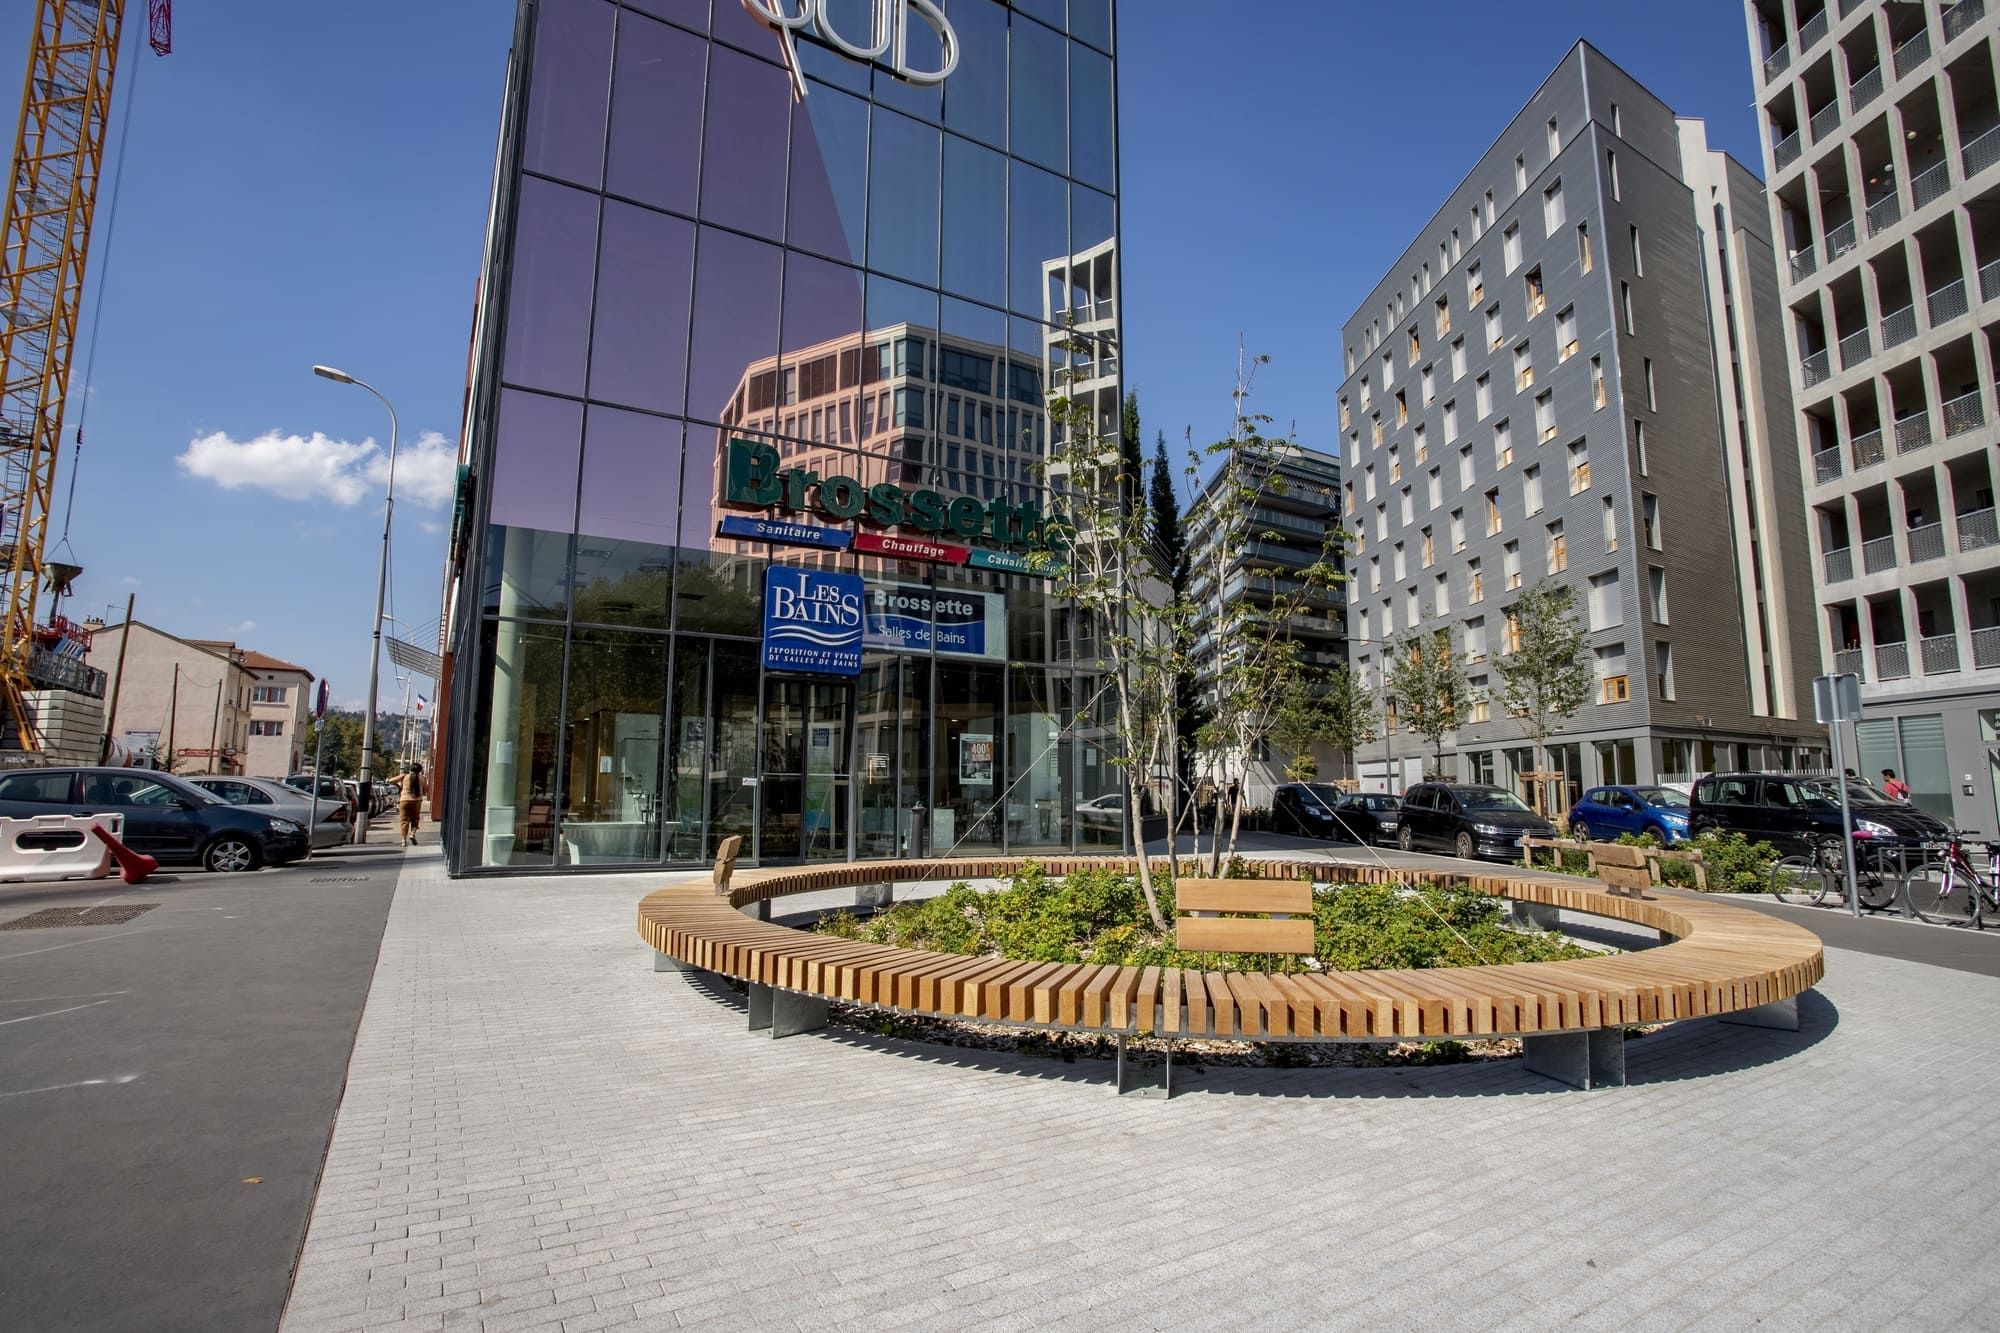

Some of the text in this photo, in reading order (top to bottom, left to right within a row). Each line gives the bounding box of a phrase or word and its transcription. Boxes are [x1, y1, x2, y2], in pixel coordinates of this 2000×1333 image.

[726, 437, 1078, 551] Brossette
[757, 523, 821, 540] Sanitaire
[882, 540, 945, 558] Chauffage
[988, 554, 1057, 572] Canalison
[796, 573, 840, 603] LES
[771, 586, 860, 626] BAINS
[874, 589, 974, 616] Brossette
[878, 625, 966, 645] Salles de Bains
[769, 646, 819, 657] EXPOSITION
[834, 652, 859, 661] VENTE
[784, 655, 815, 664] SALLES
[833, 659, 859, 668] BAINS
